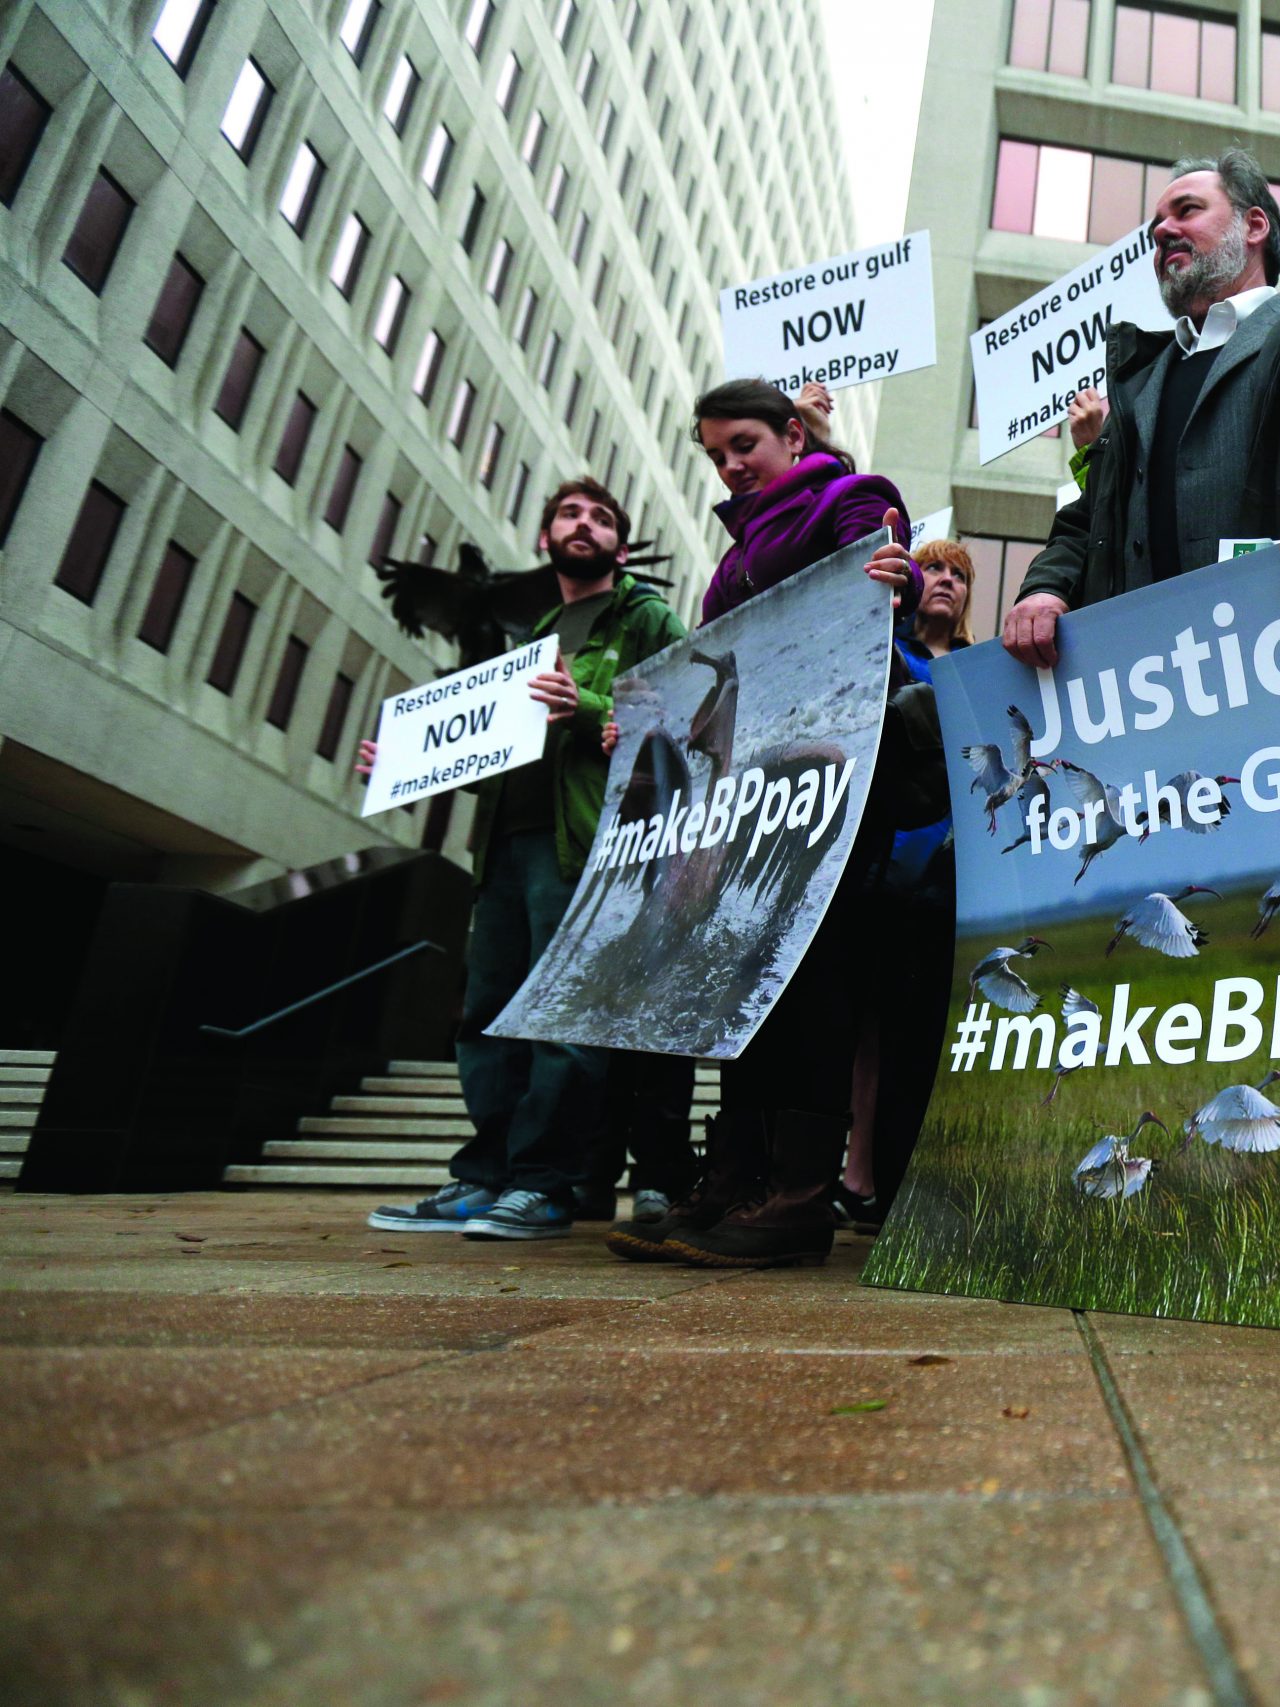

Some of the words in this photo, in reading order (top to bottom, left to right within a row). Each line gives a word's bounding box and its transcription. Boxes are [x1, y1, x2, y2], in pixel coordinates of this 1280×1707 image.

[735, 274, 815, 310] Restore
[822, 261, 859, 285] our
[866, 239, 911, 279] gulf
[984, 294, 1062, 355] Restore
[1067, 264, 1104, 301] our
[782, 299, 865, 350] NOW
[1031, 303, 1112, 383] NOW
[770, 348, 899, 394] makeBPpay
[1007, 367, 1106, 441] #makeBP
[394, 681, 461, 717] Restore
[466, 666, 498, 691] our
[502, 643, 542, 682] gulf
[423, 701, 497, 752] NOW
[390, 745, 513, 799] #makeBPpay
[593, 757, 857, 872] #makeBPpay
[1025, 794, 1104, 856] for
[1118, 769, 1222, 838] the
